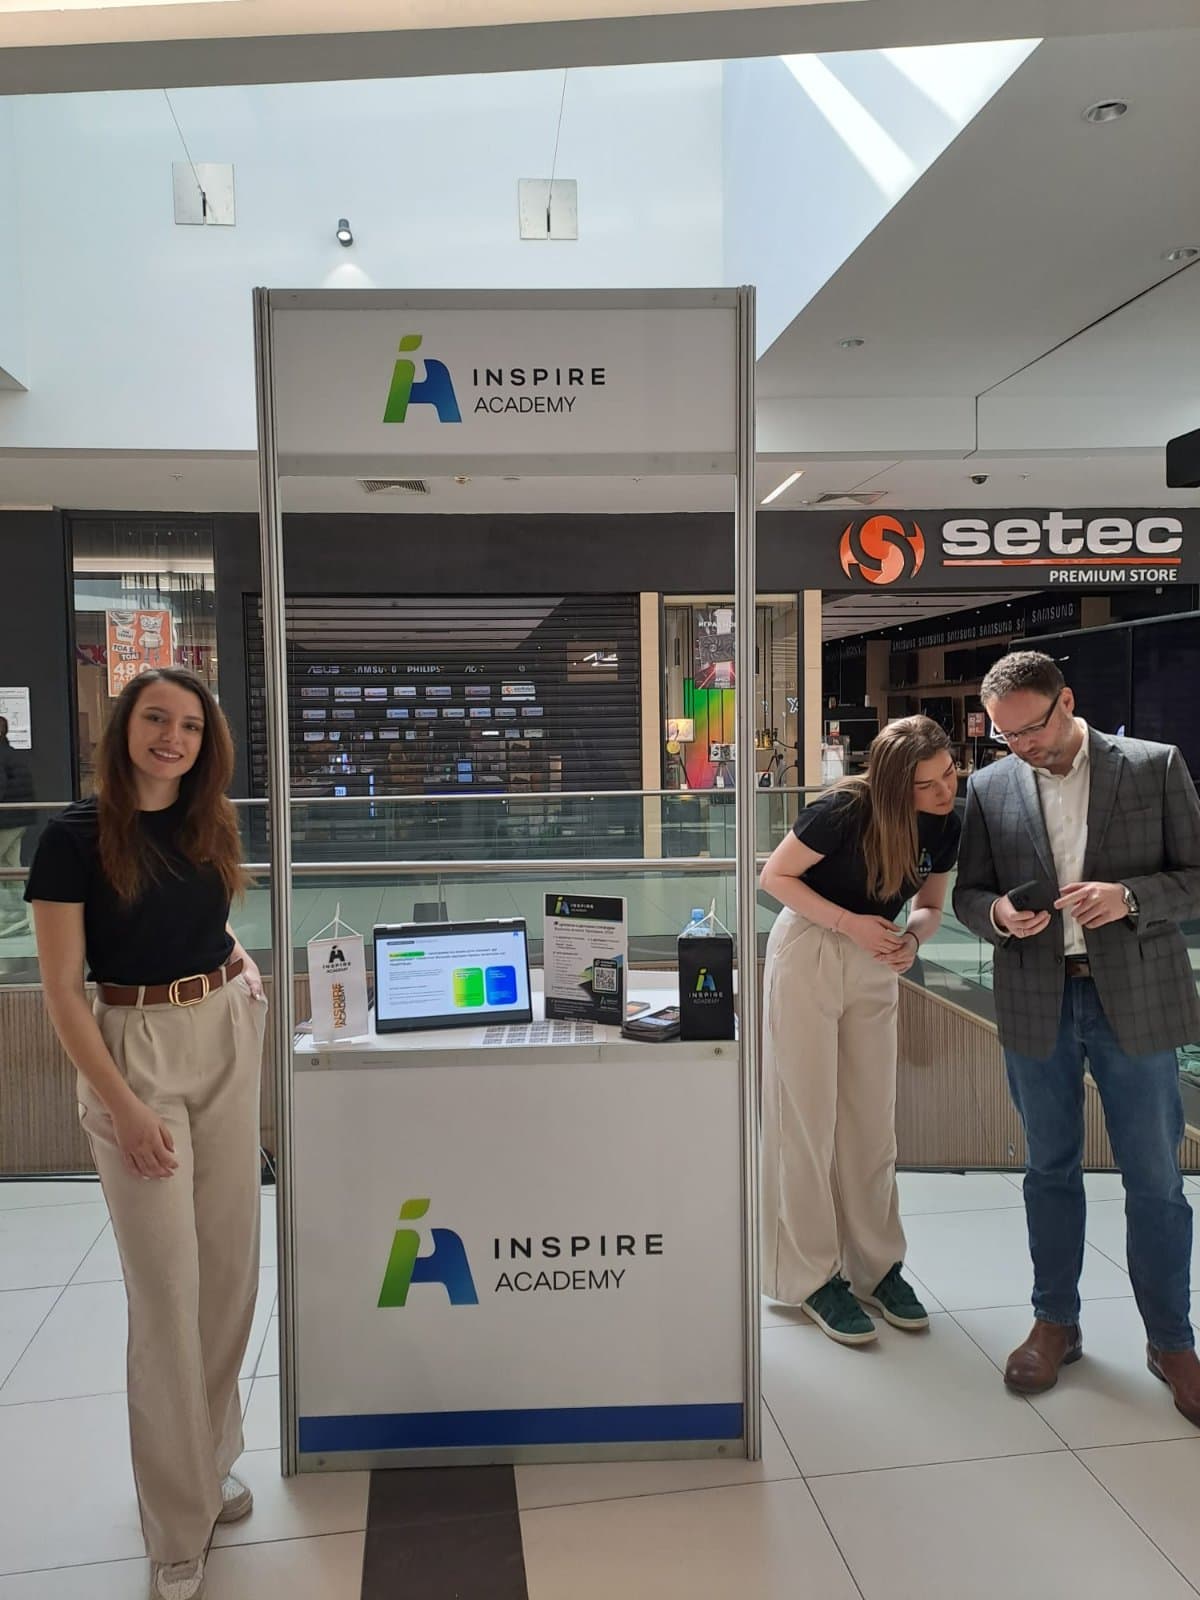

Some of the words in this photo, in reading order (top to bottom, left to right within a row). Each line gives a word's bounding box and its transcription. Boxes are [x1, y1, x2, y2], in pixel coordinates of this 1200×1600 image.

[473, 367, 606, 386] INSPIRE
[474, 396, 576, 413] ACADEMY
[942, 511, 1183, 555] setec
[1049, 569, 1126, 583] PREMIUM
[1129, 568, 1177, 582] STORE
[1031, 602, 1074, 624] SAMSUNG
[979, 620, 1013, 637] SAMSUNG
[307, 665, 340, 674] ASUS
[494, 1233, 664, 1259] INSPIRE
[494, 1269, 626, 1292] ACADEMY
